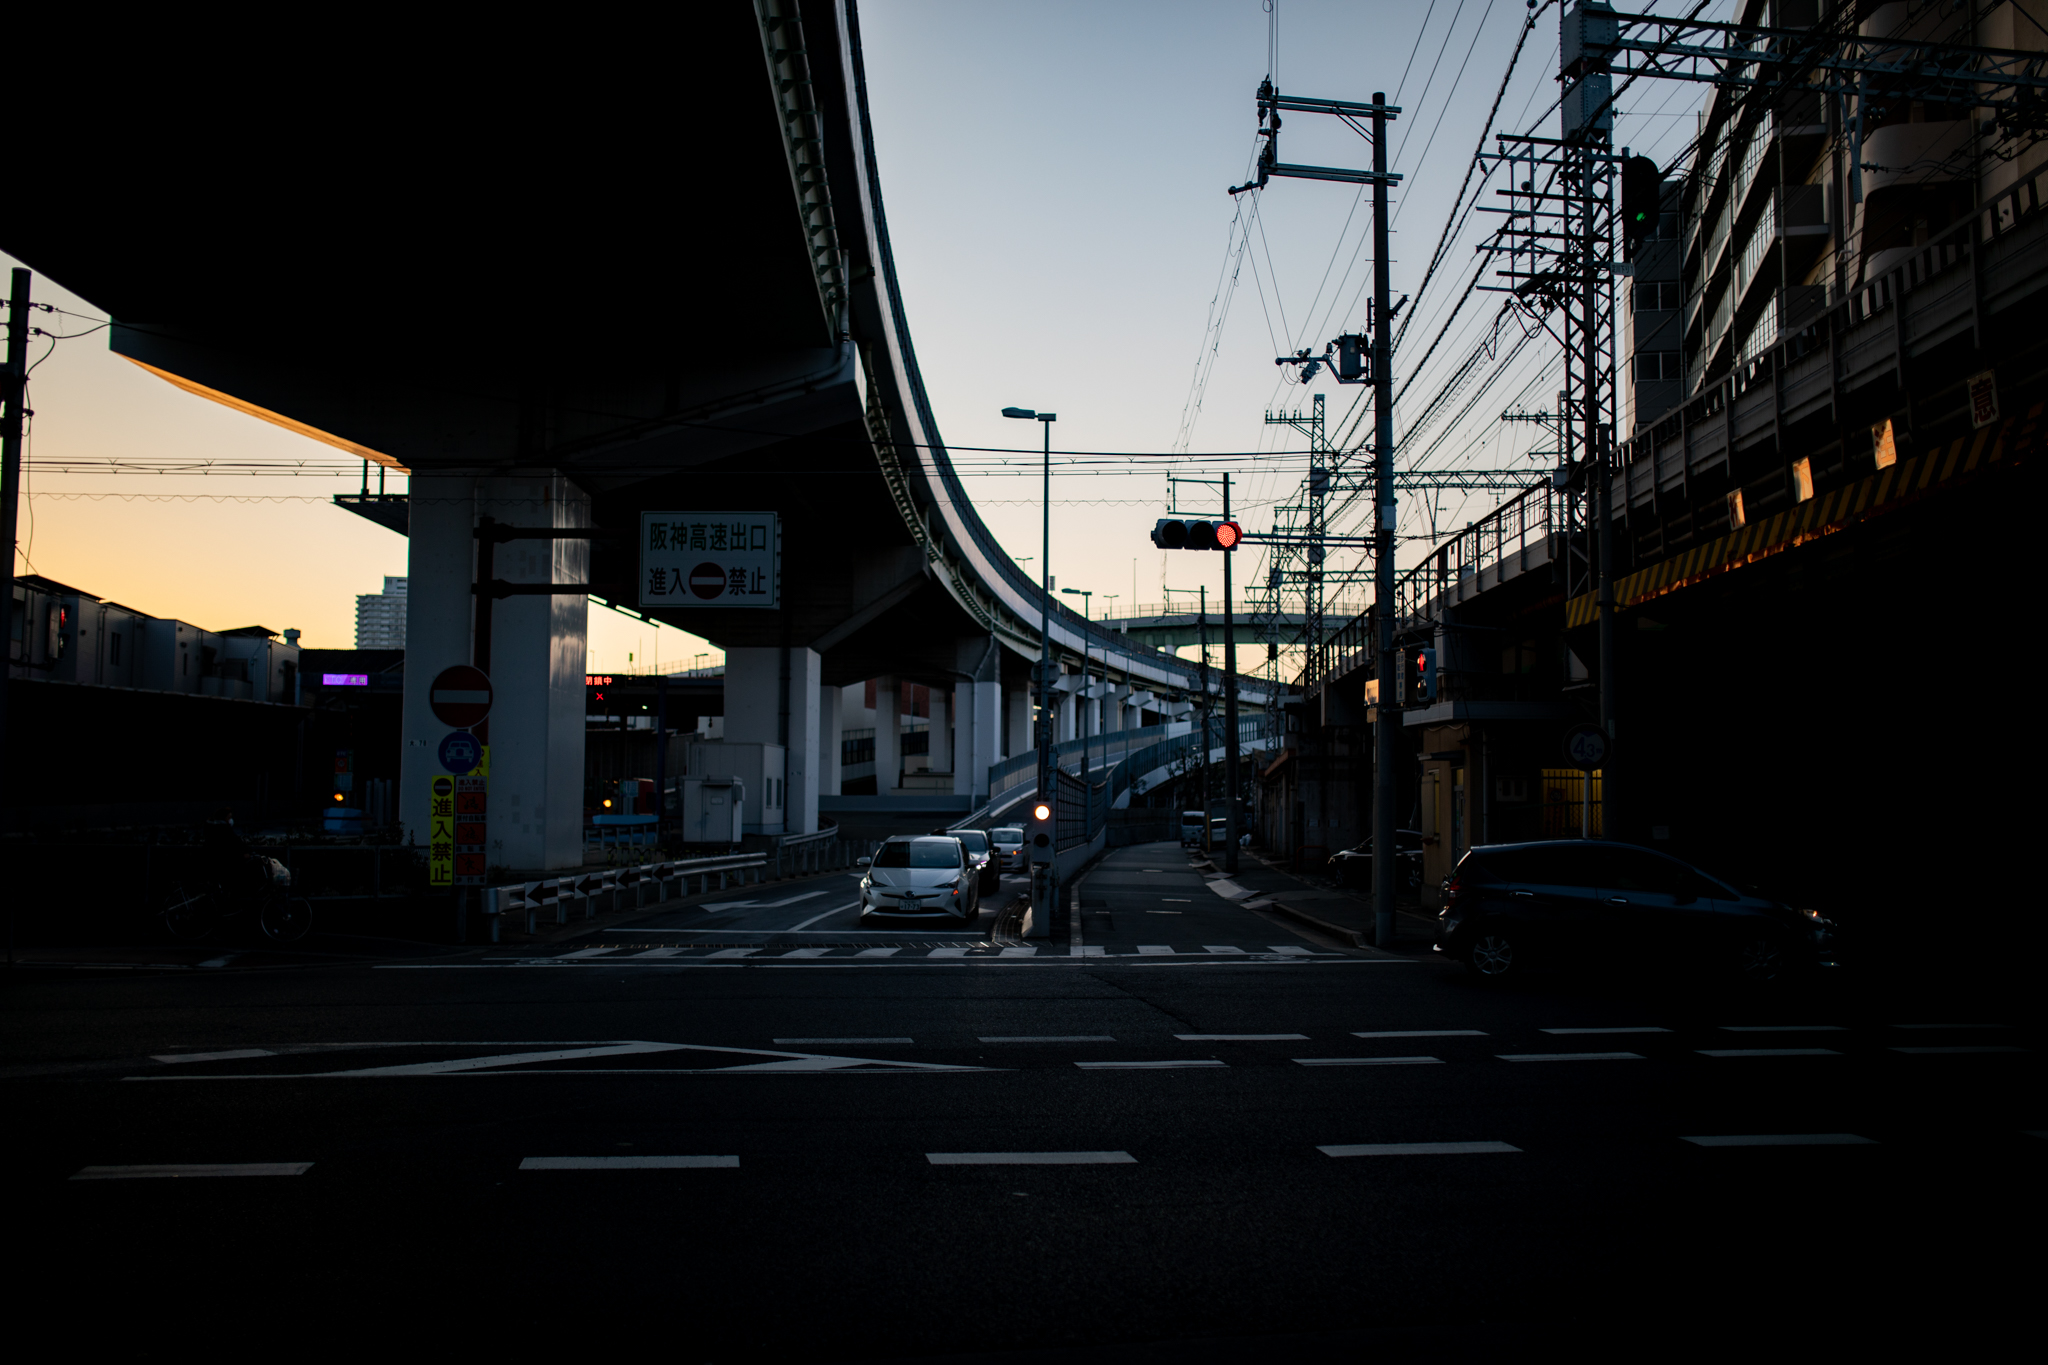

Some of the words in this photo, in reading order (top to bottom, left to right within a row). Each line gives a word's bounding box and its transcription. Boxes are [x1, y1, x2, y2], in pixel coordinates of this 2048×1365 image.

[650, 522, 766, 551] 阪神高速出口
[649, 567, 686, 595] 進入
[729, 567, 766, 595] 禁止
[432, 798, 453, 883] 進入禁止
